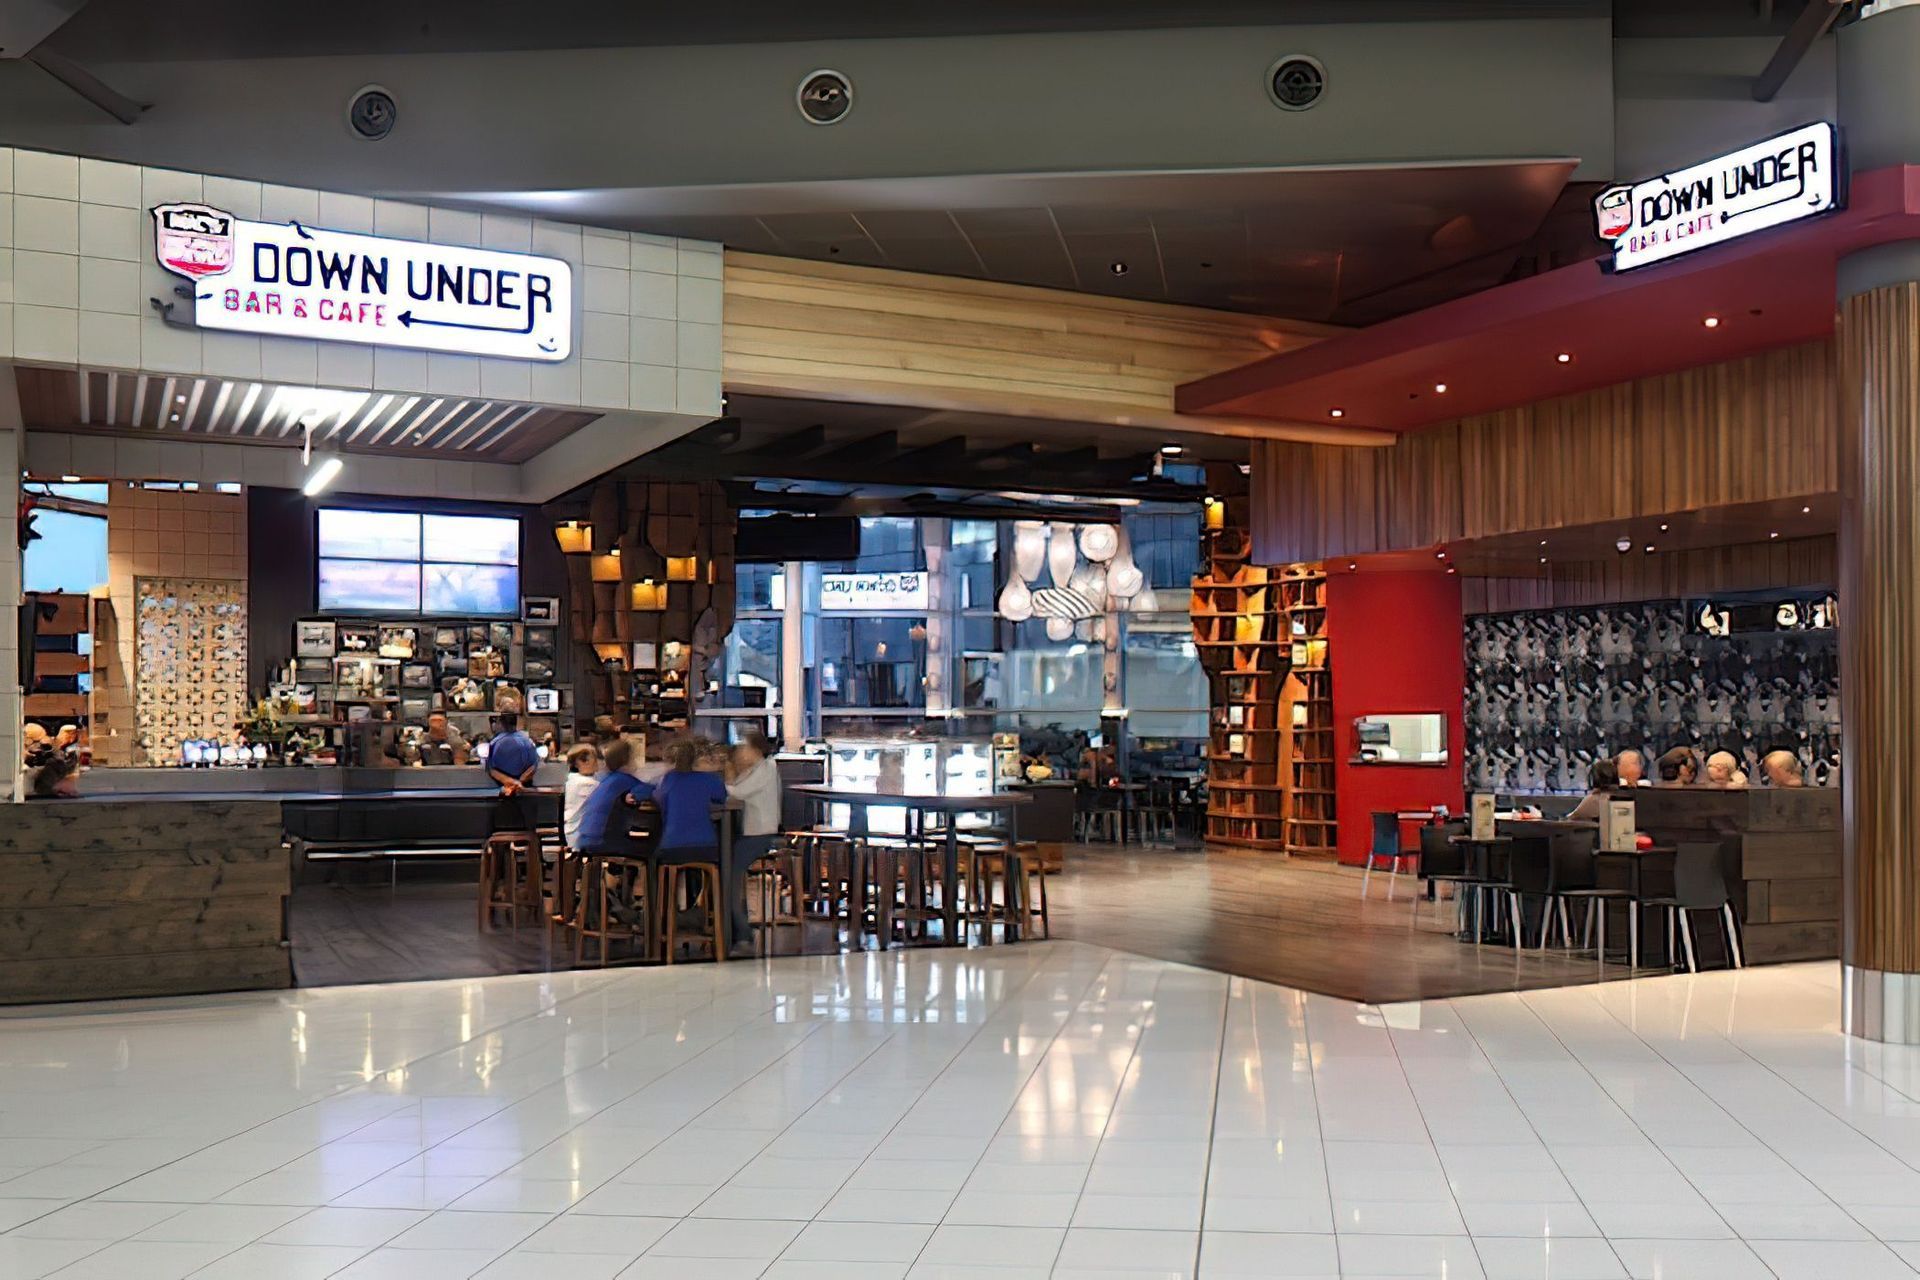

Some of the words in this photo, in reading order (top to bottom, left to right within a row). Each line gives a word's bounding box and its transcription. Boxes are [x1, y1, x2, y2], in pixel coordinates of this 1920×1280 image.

[1641, 175, 1713, 228] DOWN
[1722, 140, 1818, 199] UNDER
[223, 288, 282, 315] BAR
[293, 298, 308, 318] &
[319, 299, 388, 327] CAFE
[253, 241, 390, 295] DOWN
[406, 259, 553, 314] UNDER
